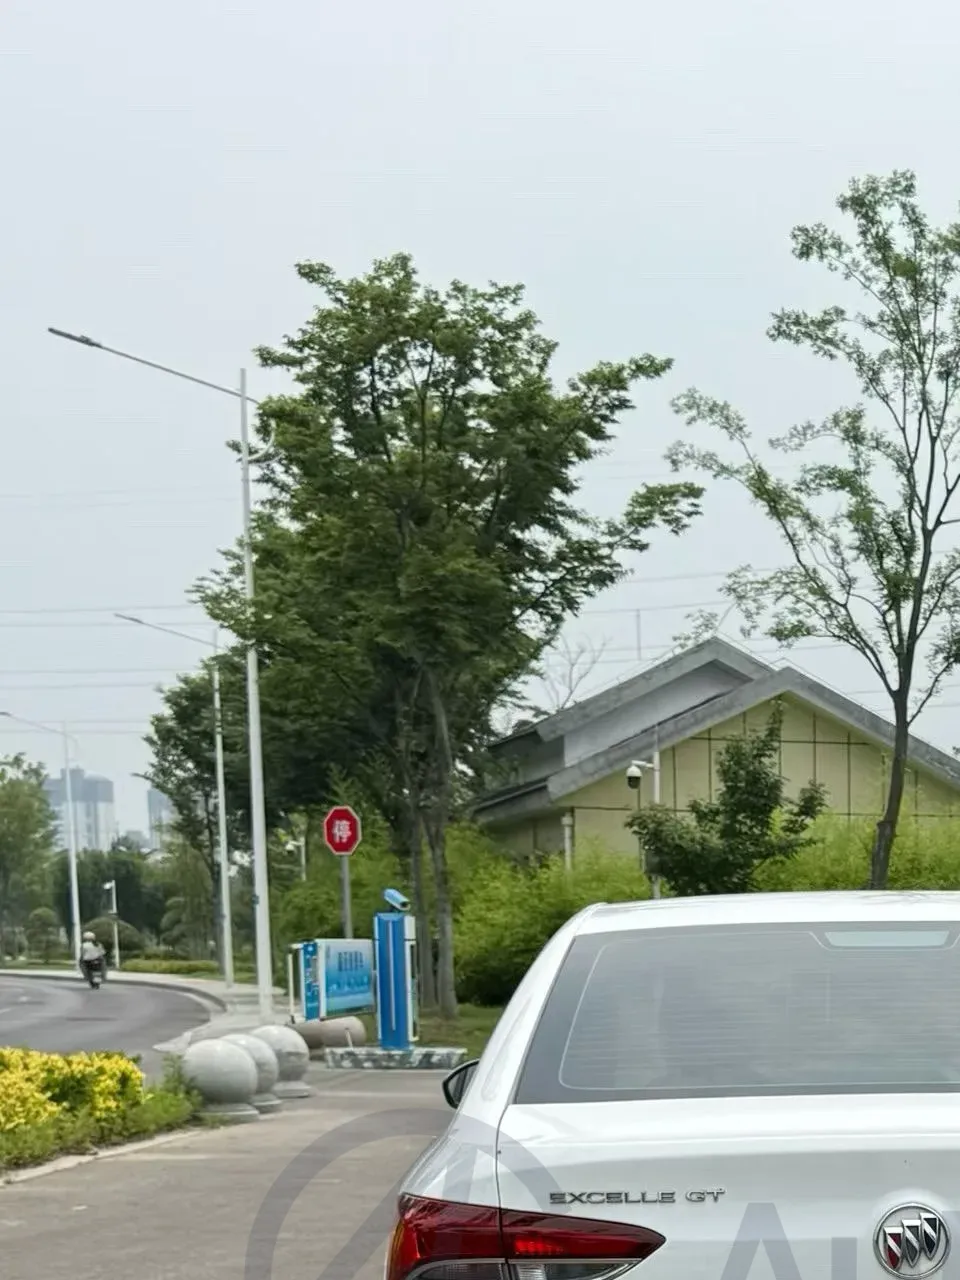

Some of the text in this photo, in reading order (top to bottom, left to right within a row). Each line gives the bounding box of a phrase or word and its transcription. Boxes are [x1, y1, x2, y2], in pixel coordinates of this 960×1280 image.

[333, 819, 352, 843] 停
[549, 1188, 726, 1205] EXCELLE GT
